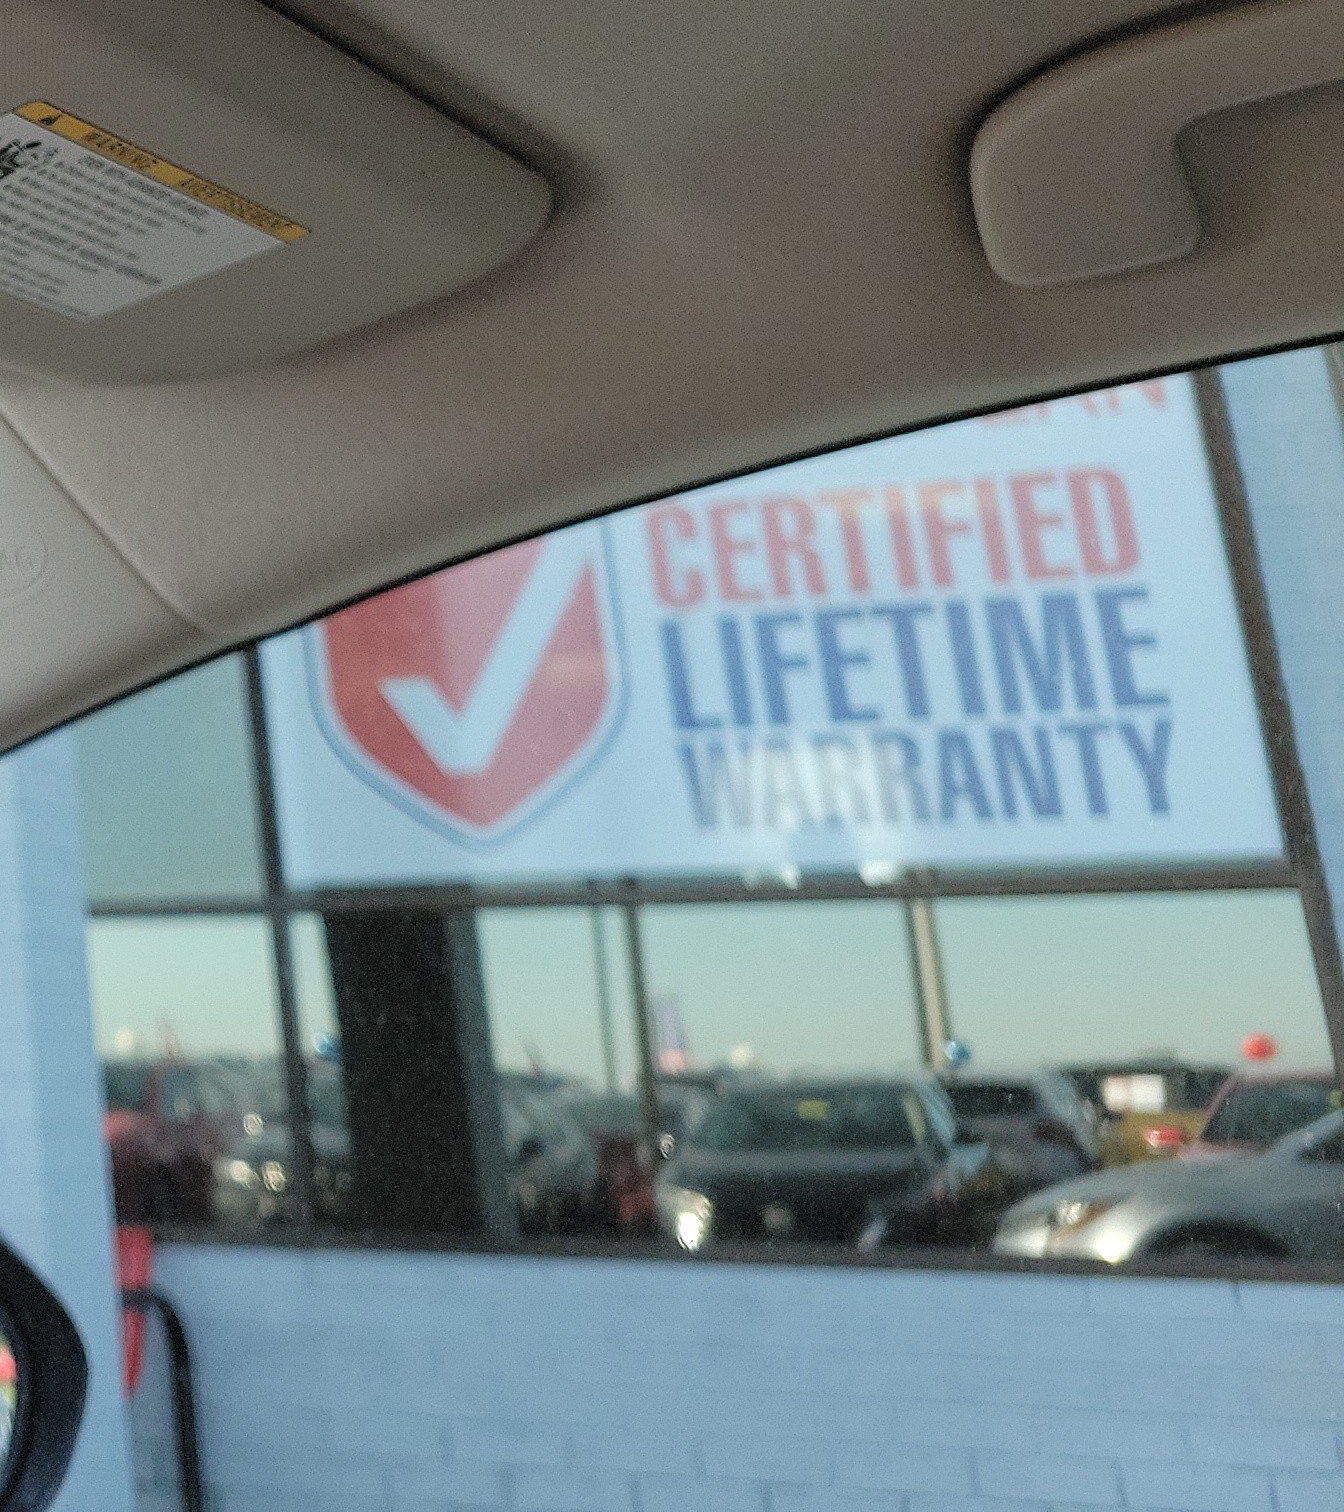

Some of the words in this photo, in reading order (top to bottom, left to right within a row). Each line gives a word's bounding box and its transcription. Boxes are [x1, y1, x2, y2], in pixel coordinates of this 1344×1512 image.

[645, 466, 1141, 612] CERTIFIED
[661, 586, 1171, 731] LIFETIME
[677, 718, 1173, 830] WARRANTY
